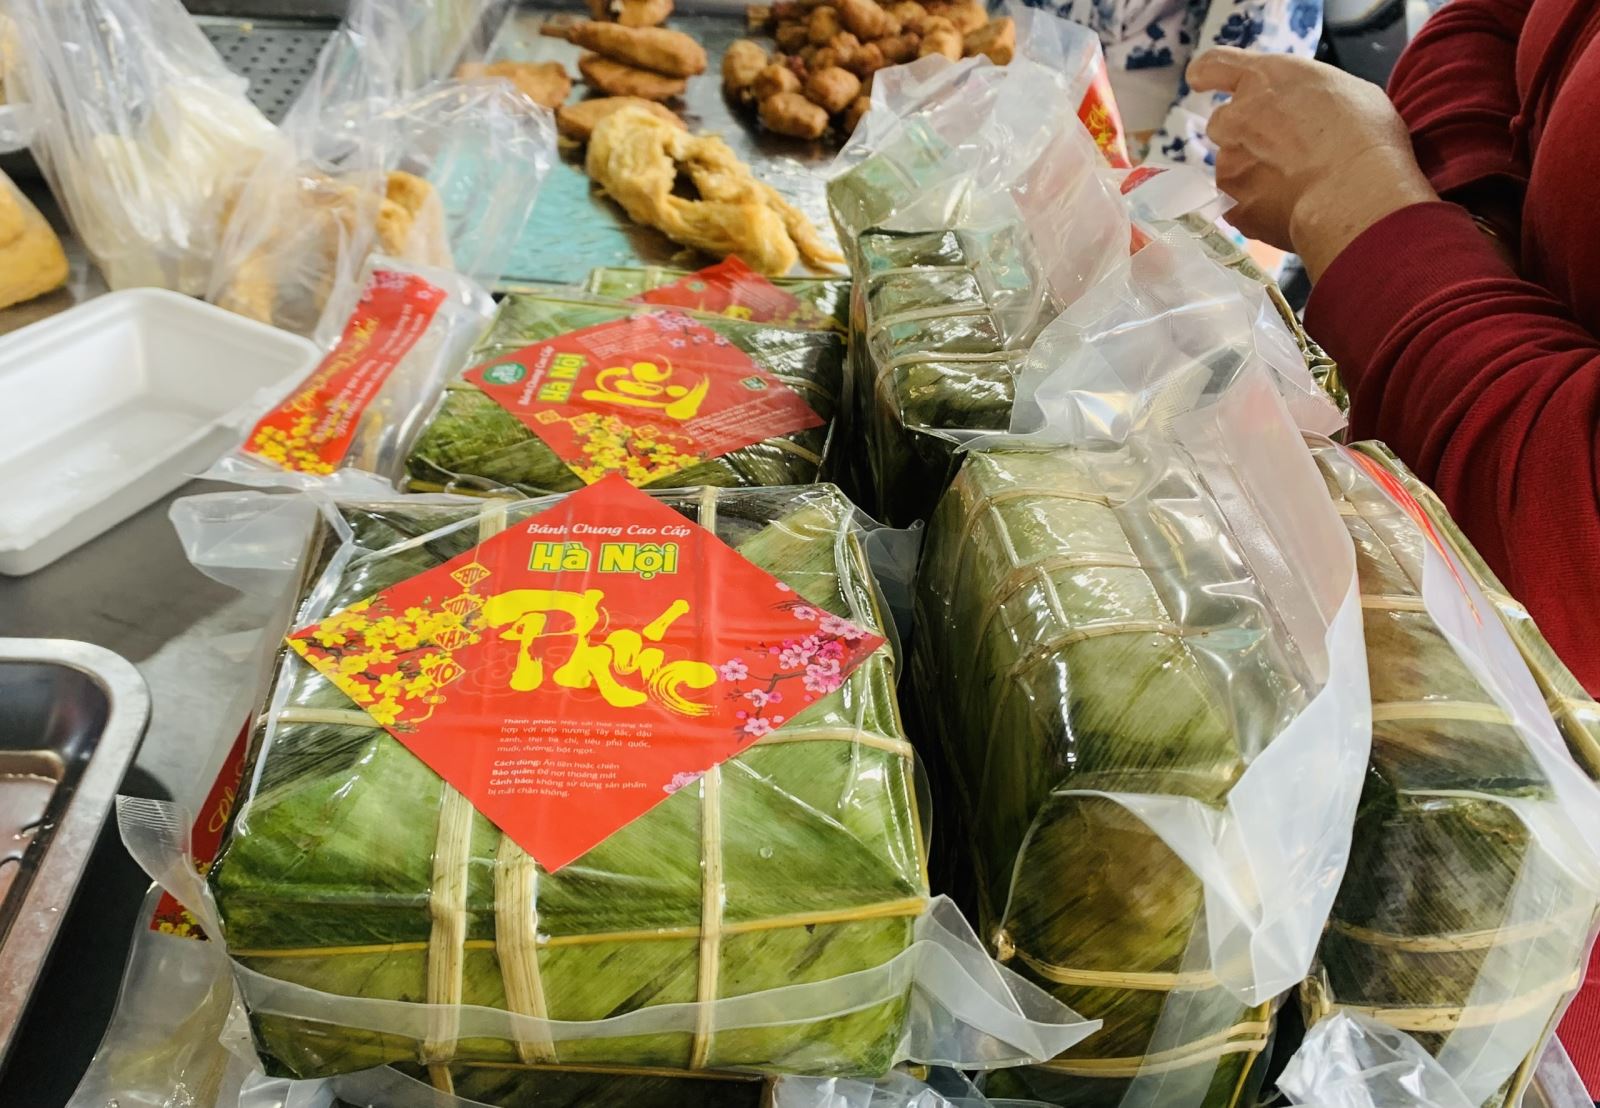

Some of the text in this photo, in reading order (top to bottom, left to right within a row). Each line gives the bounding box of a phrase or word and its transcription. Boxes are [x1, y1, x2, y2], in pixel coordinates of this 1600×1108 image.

[538, 381, 571, 402] Hà
[527, 523, 567, 534] Bánh
[627, 525, 657, 535] Cao
[661, 524, 691, 537] Cấp
[529, 541, 679, 580] Hà Nội
[480, 589, 719, 717] Phúc
